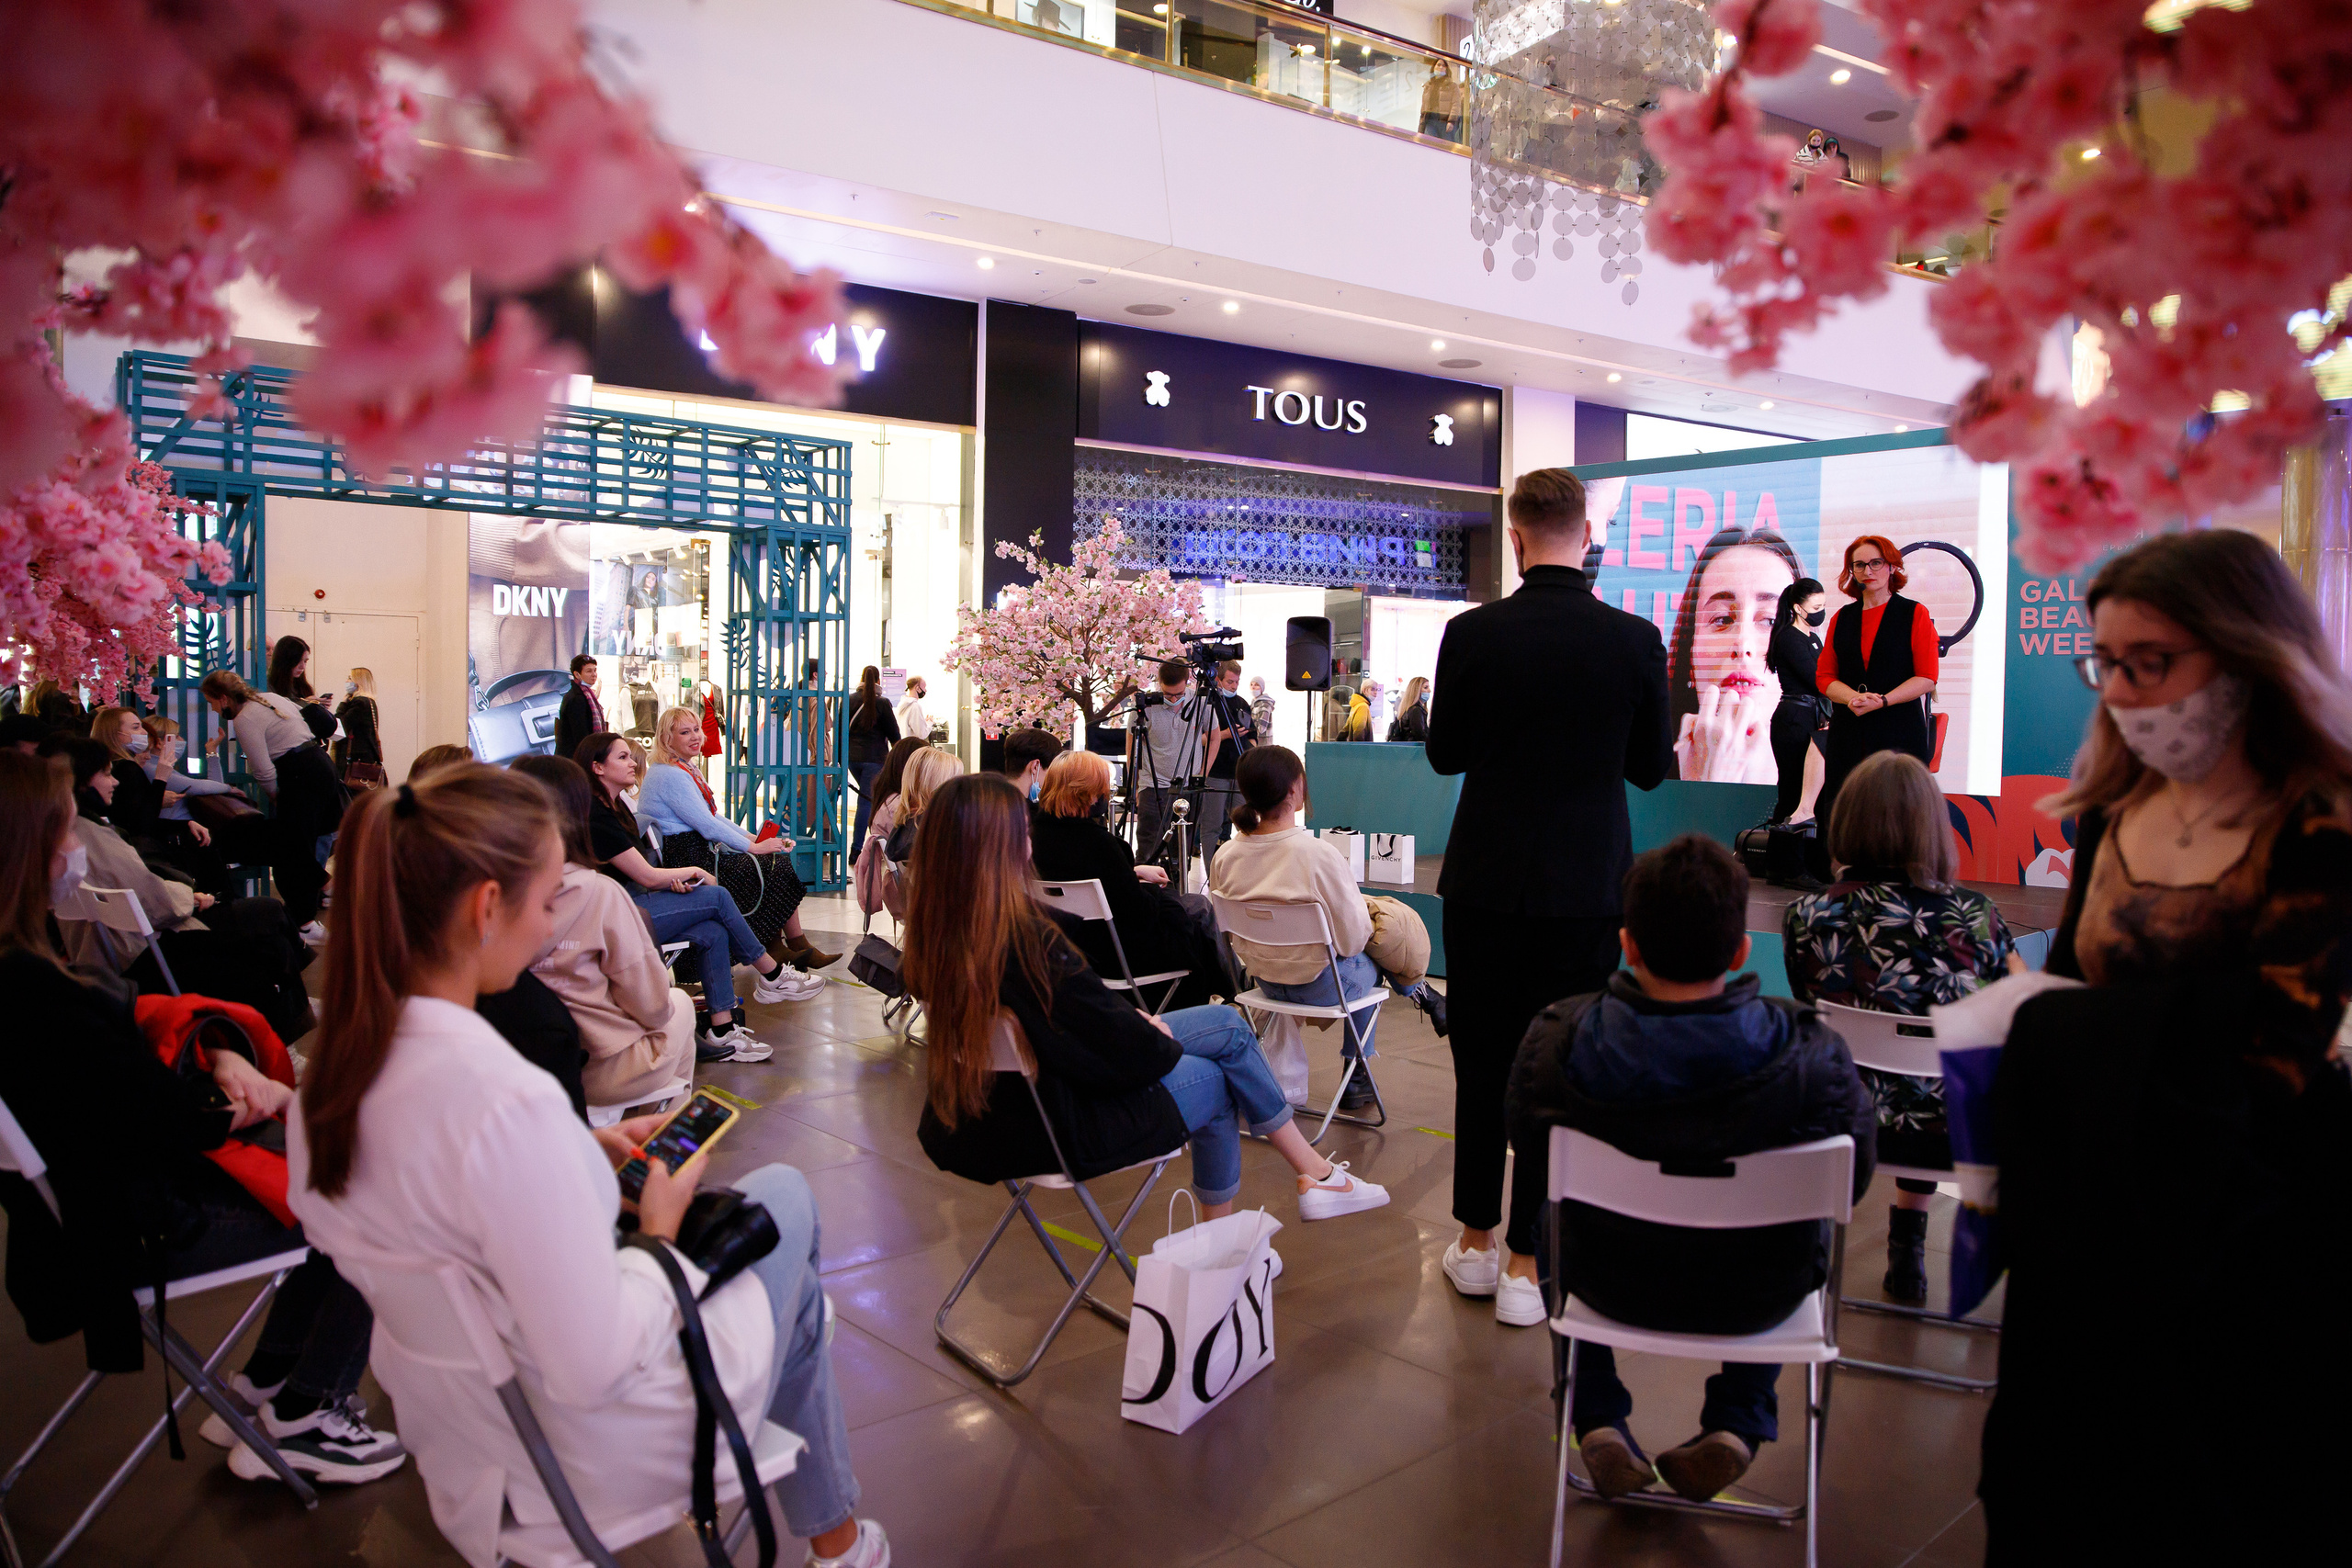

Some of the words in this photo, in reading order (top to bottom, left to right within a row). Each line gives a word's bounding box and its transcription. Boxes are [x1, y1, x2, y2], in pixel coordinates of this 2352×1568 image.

[1244, 384, 1367, 434] TOUS
[492, 583, 568, 618] DKNY
[2019, 579, 2098, 604] GAL
[1371, 854, 1401, 863] GIVENCHY
